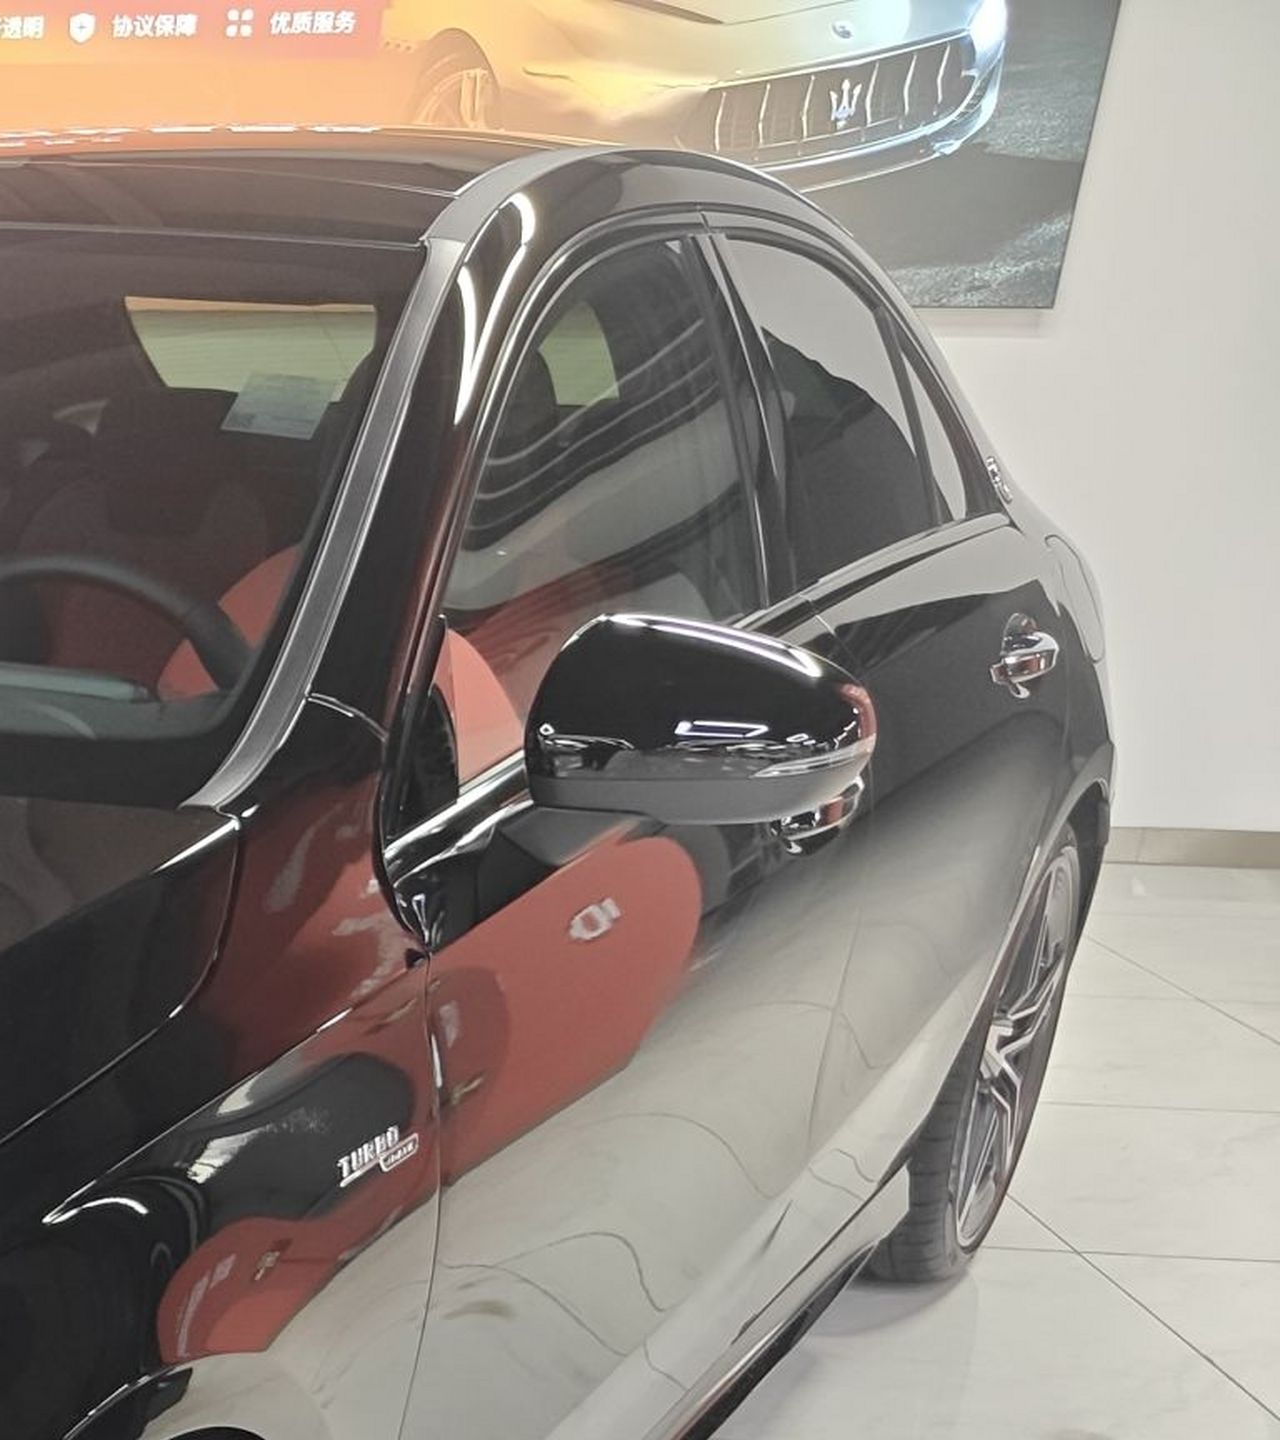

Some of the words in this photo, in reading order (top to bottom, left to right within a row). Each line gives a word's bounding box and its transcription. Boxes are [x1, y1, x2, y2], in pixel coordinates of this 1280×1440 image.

[111, 12, 198, 38] 协议保障
[269, 10, 357, 35] 优质服务
[337, 1125, 400, 1178] TURBO
